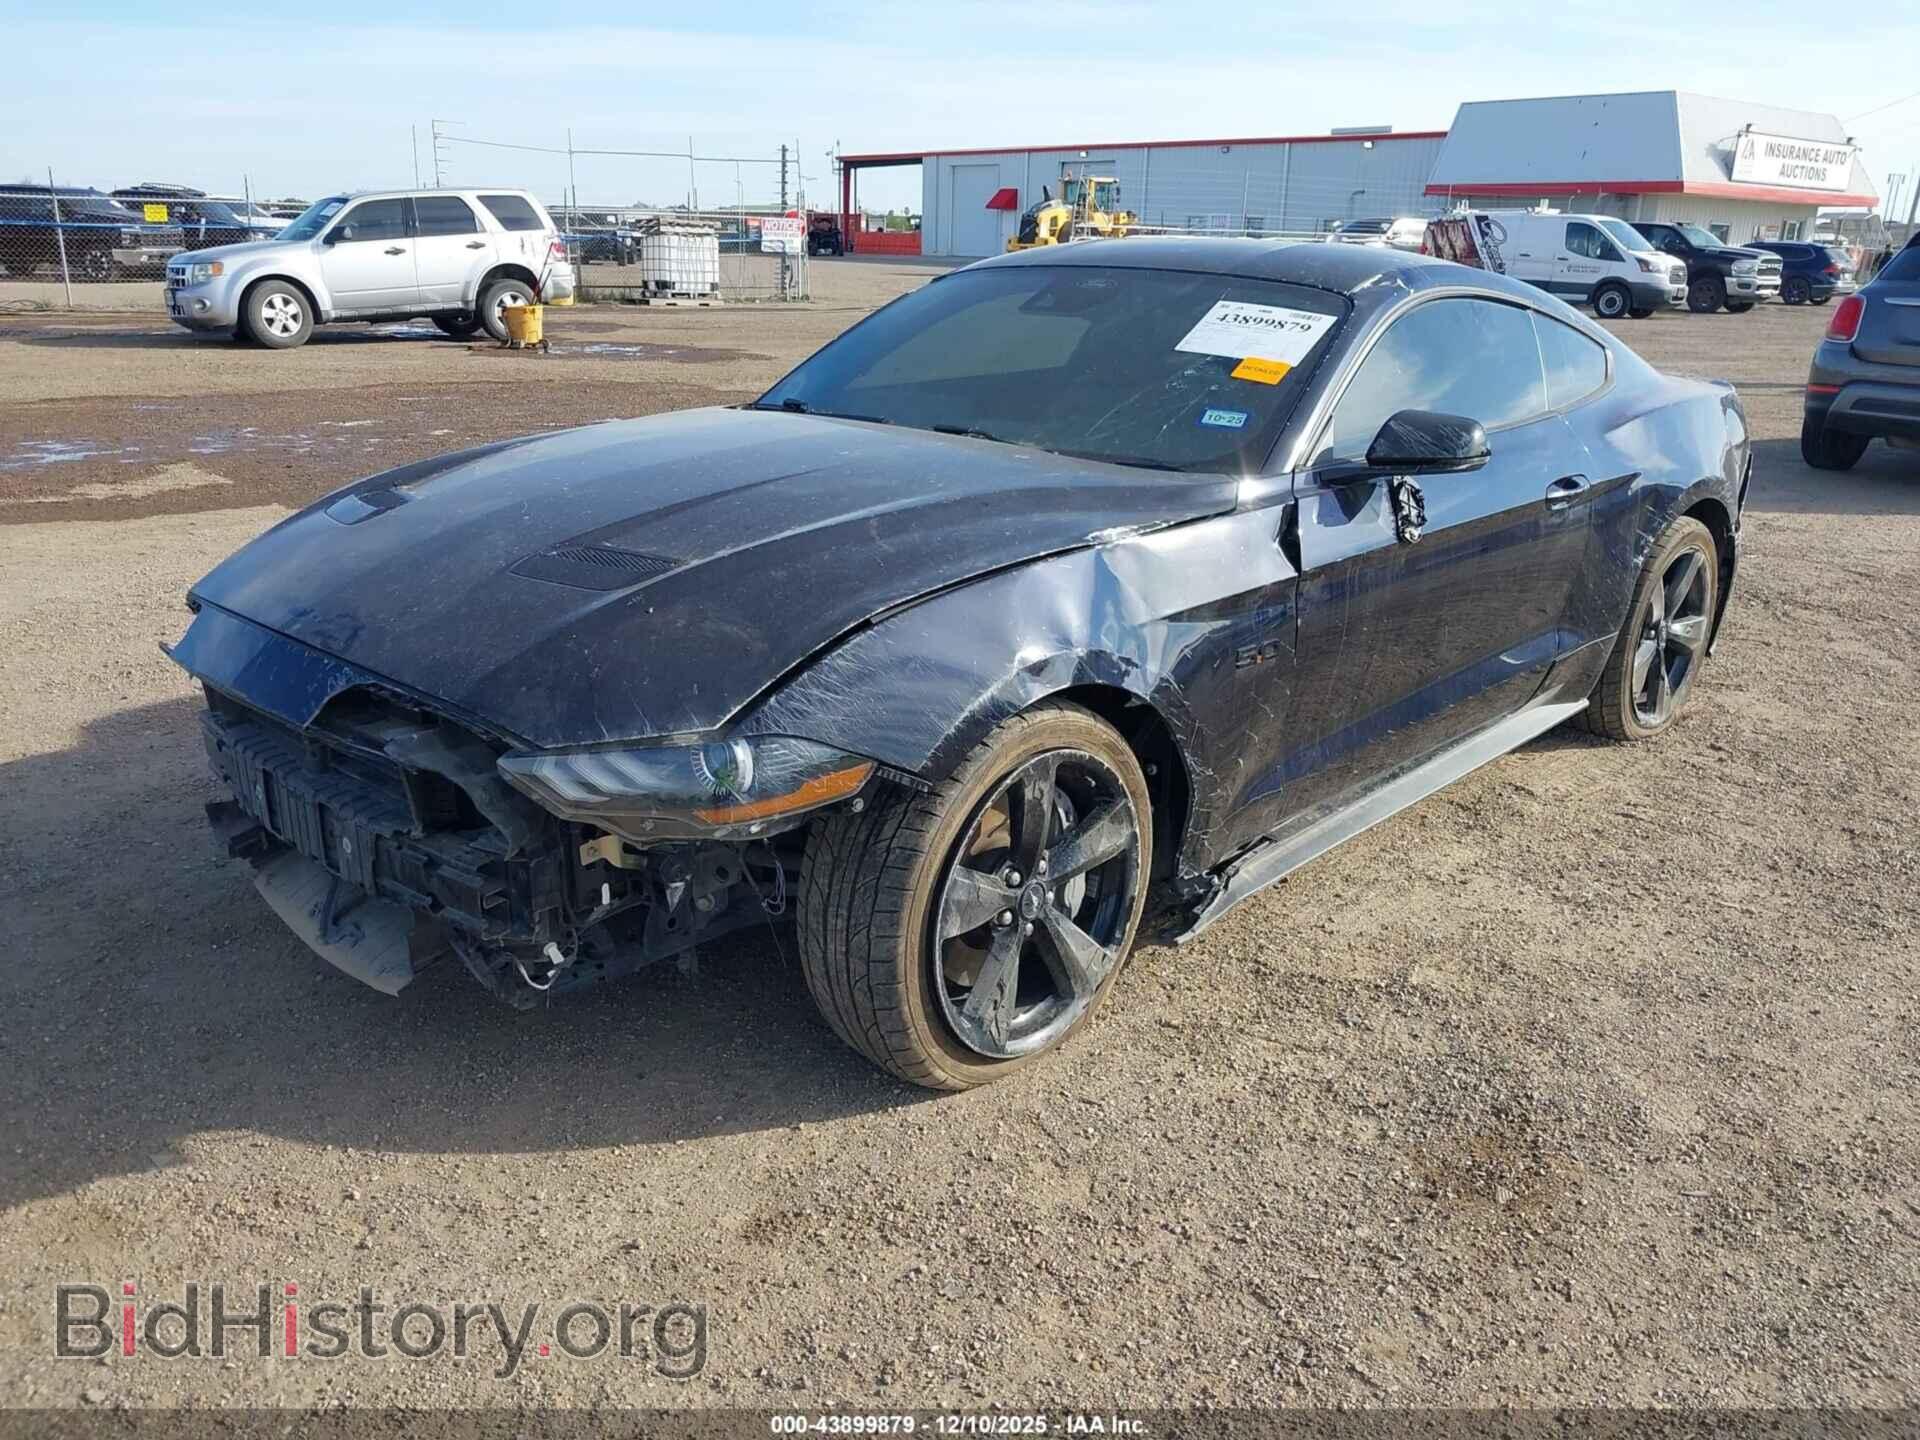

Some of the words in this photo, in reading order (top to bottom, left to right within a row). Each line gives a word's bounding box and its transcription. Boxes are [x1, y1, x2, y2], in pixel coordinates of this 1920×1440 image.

[1764, 141, 1821, 163] INSURANCE
[1822, 150, 1848, 165] AUTO
[1779, 163, 1828, 182] AUCTIONS
[763, 219, 800, 231] NOTICE
[1216, 313, 1312, 332] 43899879
[1207, 411, 1243, 425] 10-25
